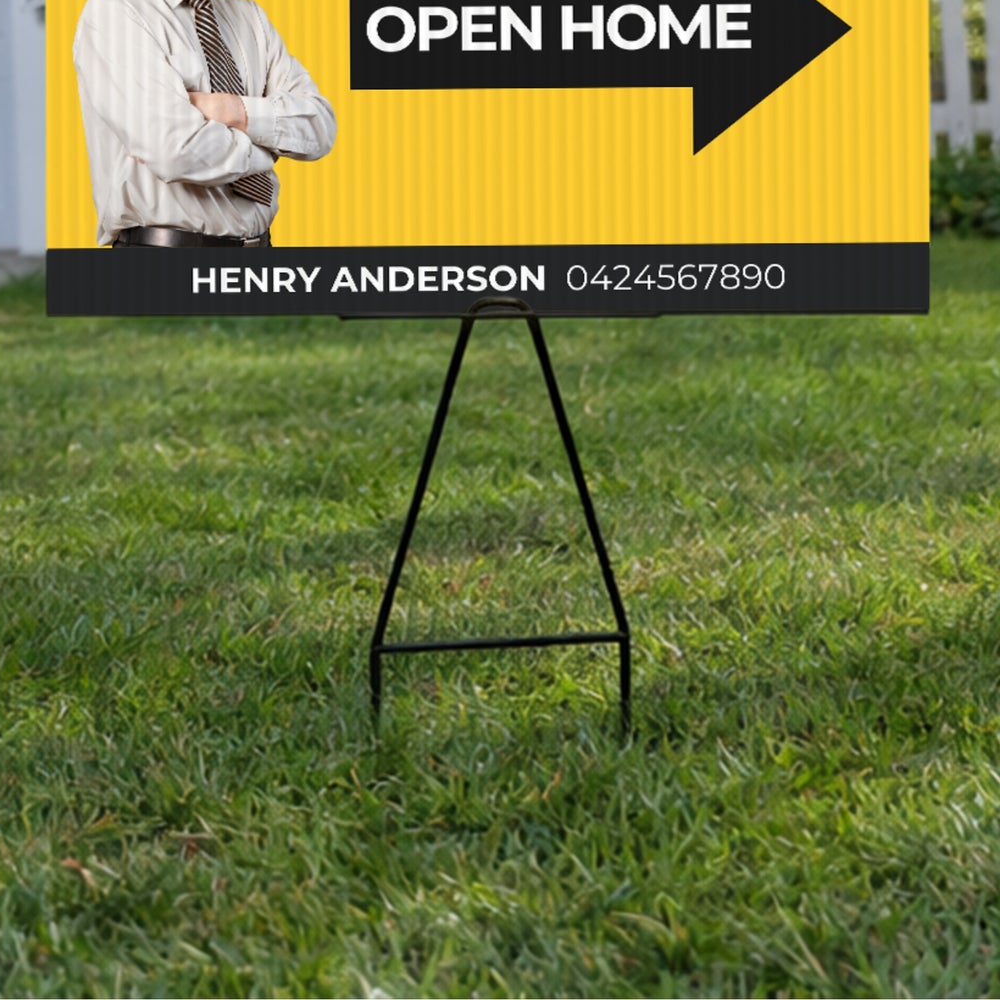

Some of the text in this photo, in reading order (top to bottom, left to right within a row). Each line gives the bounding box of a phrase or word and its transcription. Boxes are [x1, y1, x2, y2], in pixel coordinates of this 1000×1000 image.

[367, 4, 751, 52] OPEN HOME
[192, 263, 786, 294] HENRY ANDERSON 0424567890
